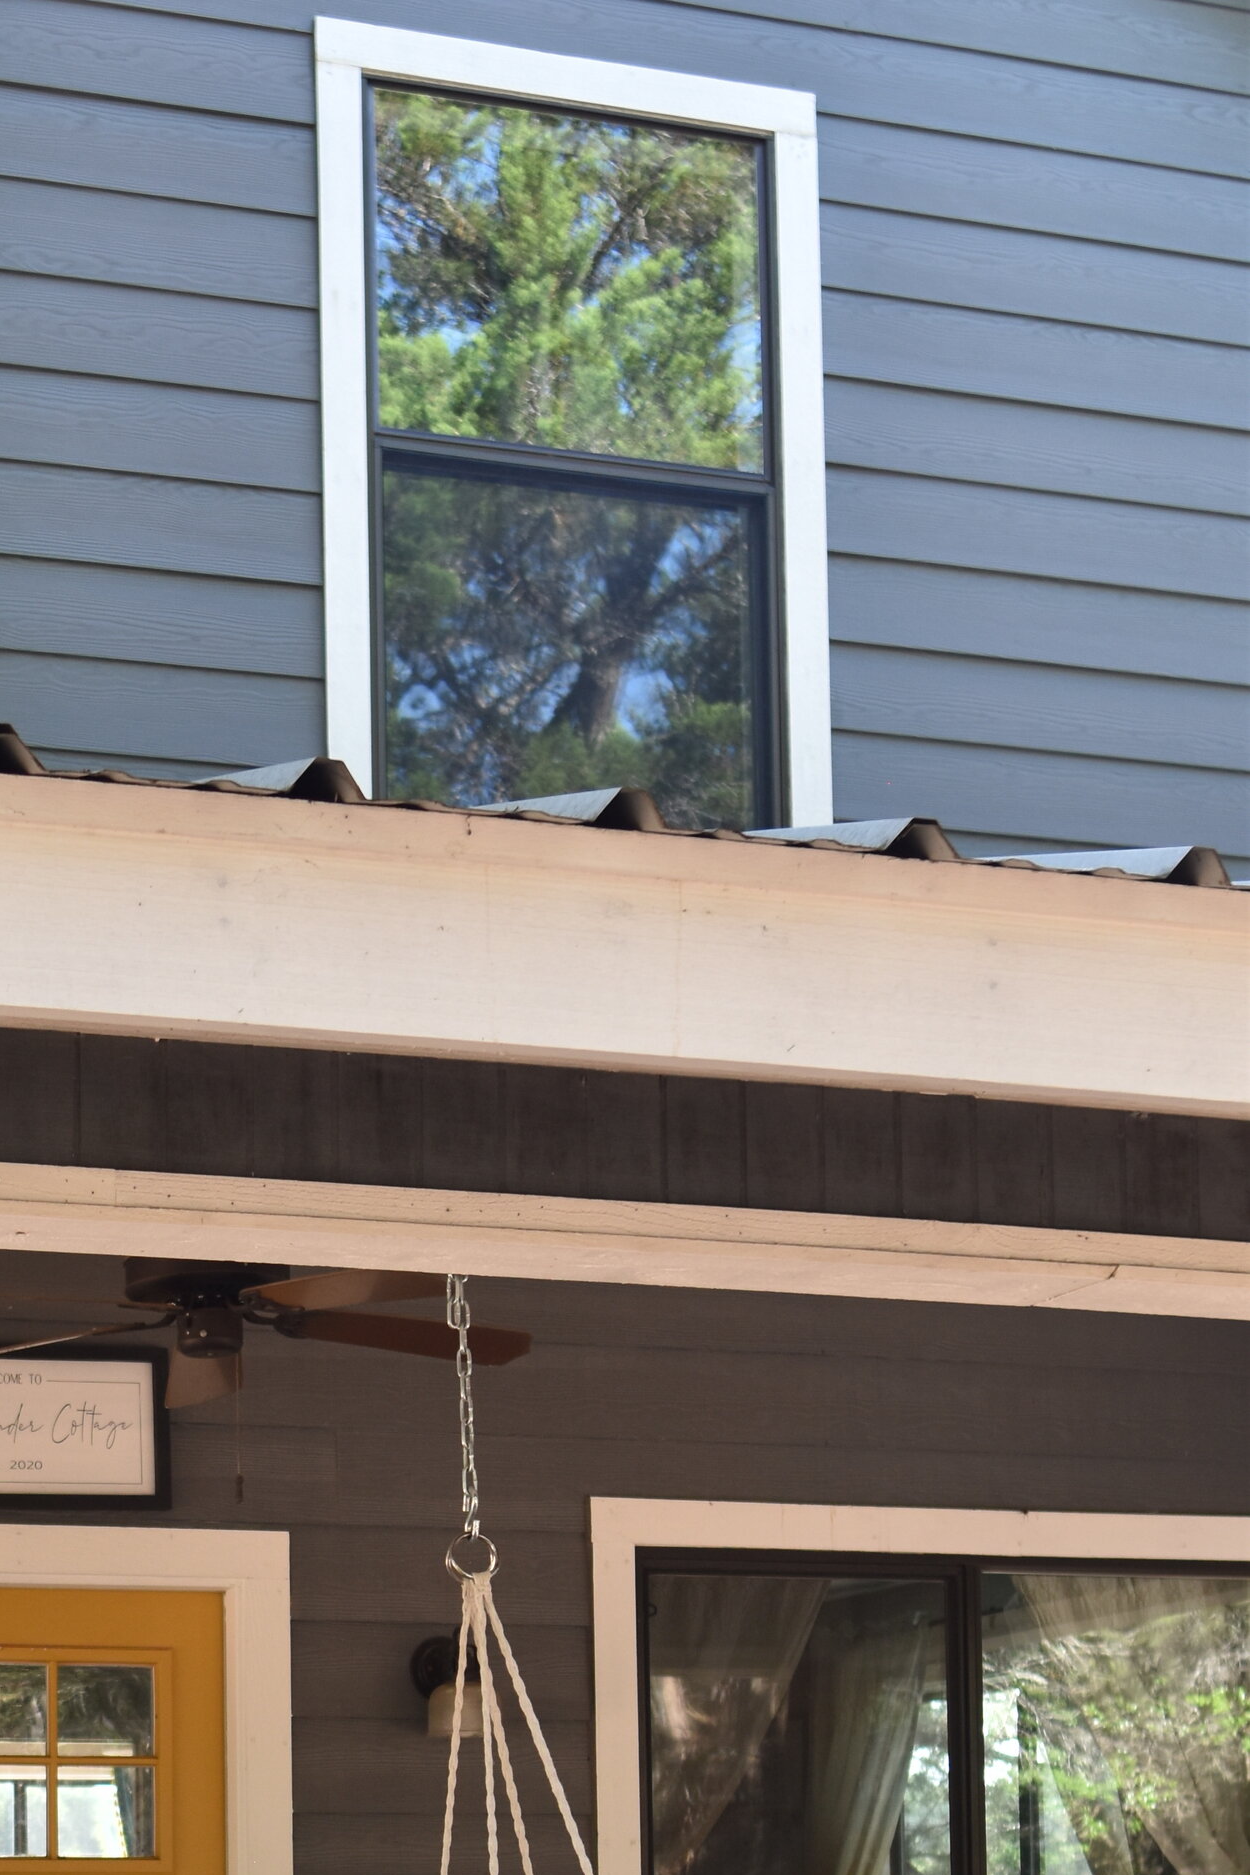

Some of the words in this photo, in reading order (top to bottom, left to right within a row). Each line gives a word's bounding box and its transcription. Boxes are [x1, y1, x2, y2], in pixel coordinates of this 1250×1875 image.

[29, 1374, 42, 1385] TO
[51, 1401, 133, 1450] Cottage
[9, 1460, 43, 1471] 2020
